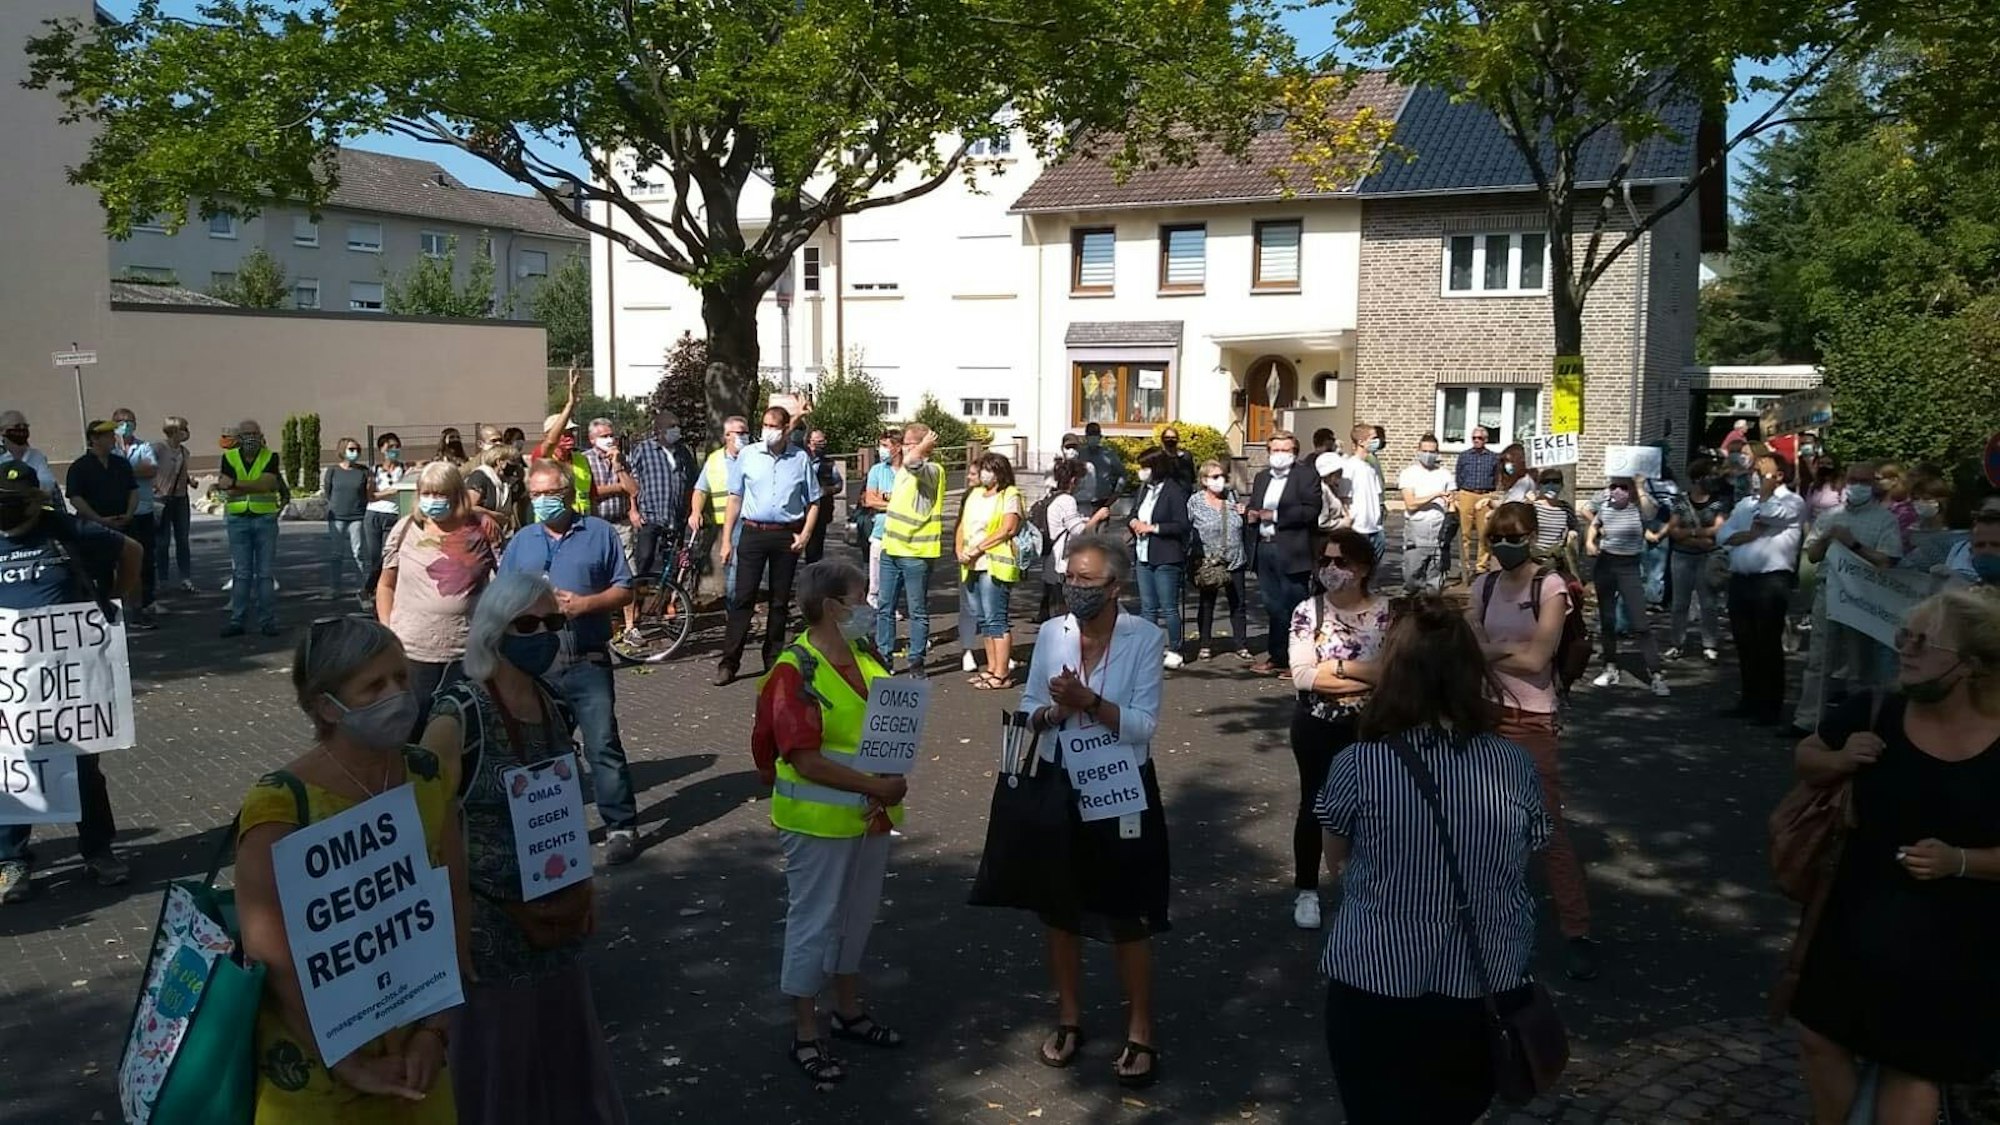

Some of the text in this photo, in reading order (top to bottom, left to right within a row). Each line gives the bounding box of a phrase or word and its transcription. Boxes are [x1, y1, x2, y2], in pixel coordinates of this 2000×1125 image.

[1534, 434, 1574, 450] EKEL
[40, 660, 81, 702] DIE
[880, 690, 919, 708] OMAS
[870, 715, 919, 733] GEGEN
[860, 740, 916, 759] RECHTS
[1070, 731, 1120, 753] Omas
[3, 756, 49, 794] IST
[1077, 760, 1129, 785] gegen
[528, 784, 562, 803] OMAS
[1081, 787, 1140, 809] Rechts
[528, 807, 570, 829] GEGEN
[304, 812, 398, 879] OMAS
[529, 831, 576, 856] RECHTS
[305, 855, 417, 933] GEGEN
[306, 899, 435, 990] RECHTS
[375, 970, 447, 1020] #omasgegenrechts
[326, 983, 408, 1040] omasgegenrechts.de
